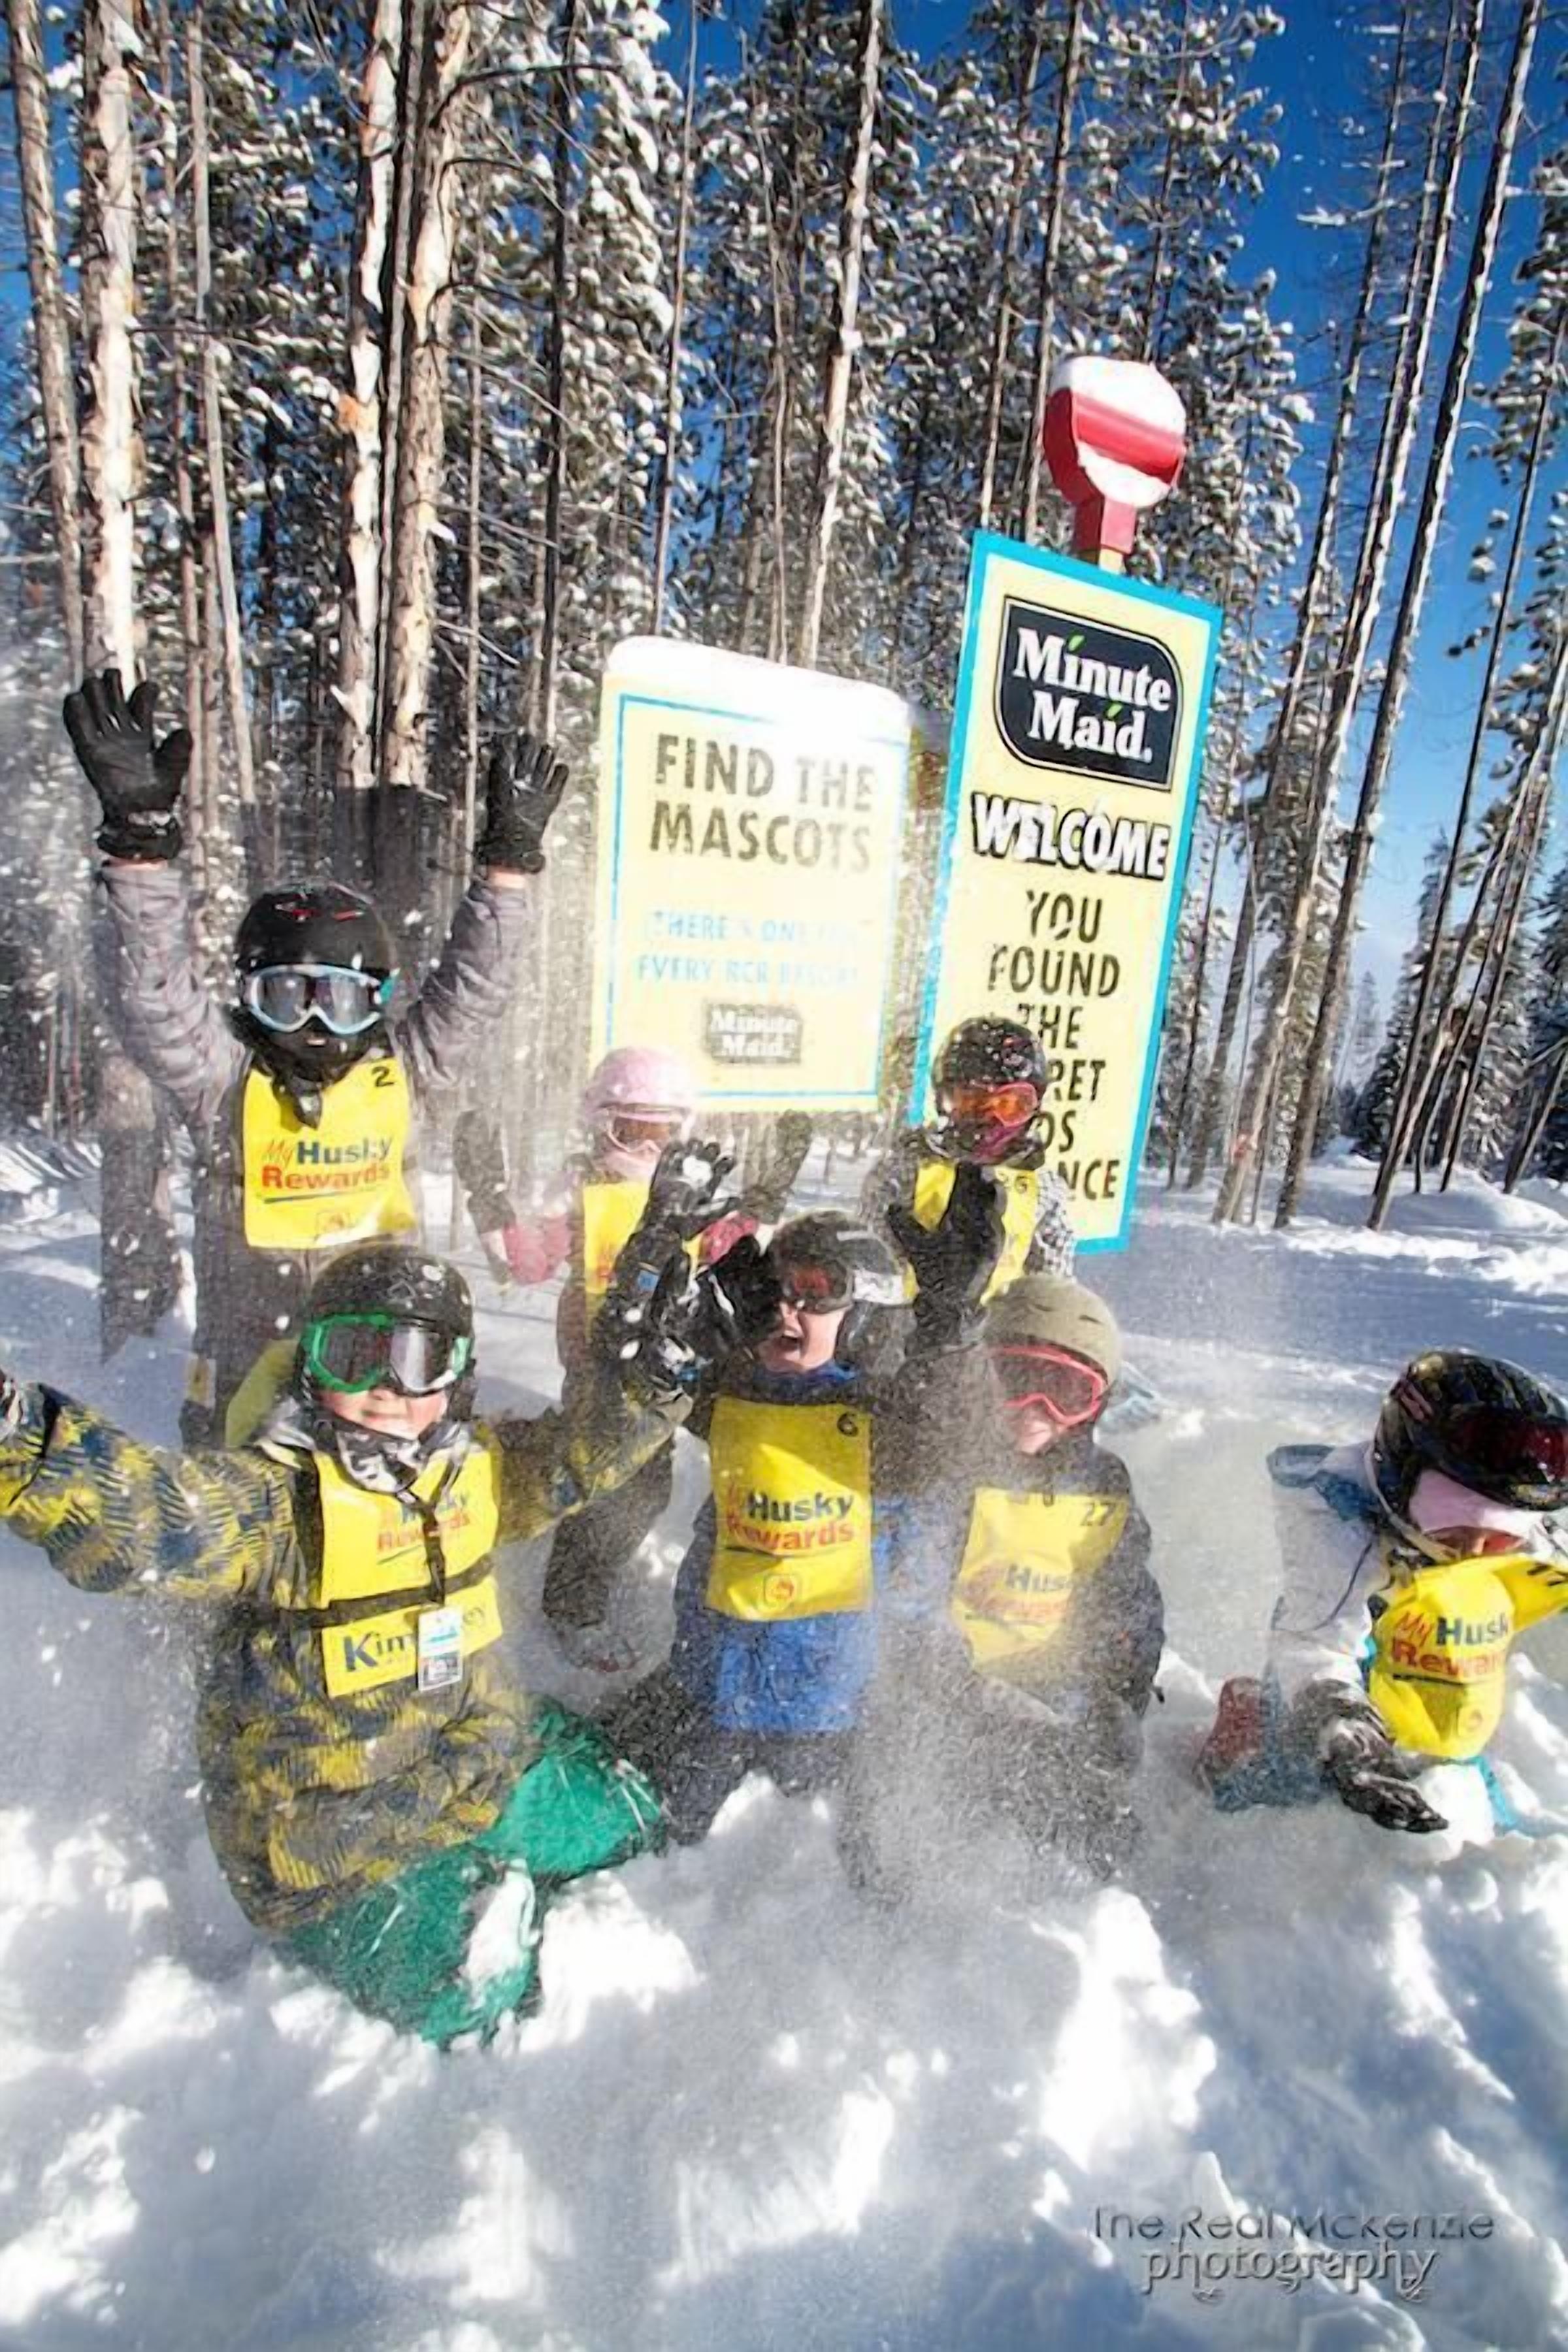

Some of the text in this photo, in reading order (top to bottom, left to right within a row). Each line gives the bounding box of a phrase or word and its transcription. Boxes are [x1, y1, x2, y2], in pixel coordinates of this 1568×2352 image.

[1012, 627, 1171, 711] Minute
[655, 732, 875, 811] FIND THE
[650, 791, 872, 872] MASCOTS
[970, 791, 1171, 881] WELCOME
[1026, 889, 1103, 943] YOU
[988, 943, 1120, 998] FOUND
[1017, 1003, 1085, 1050] THE
[370, 1066, 395, 1088] 2
[1047, 1058, 1106, 1102] RET
[297, 1136, 394, 1165] Husky
[261, 1164, 390, 1190] Rewards
[747, 1491, 855, 1522] Husky
[1436, 1612, 1509, 1646] Husk
[1391, 1637, 1501, 1678] Rewar
